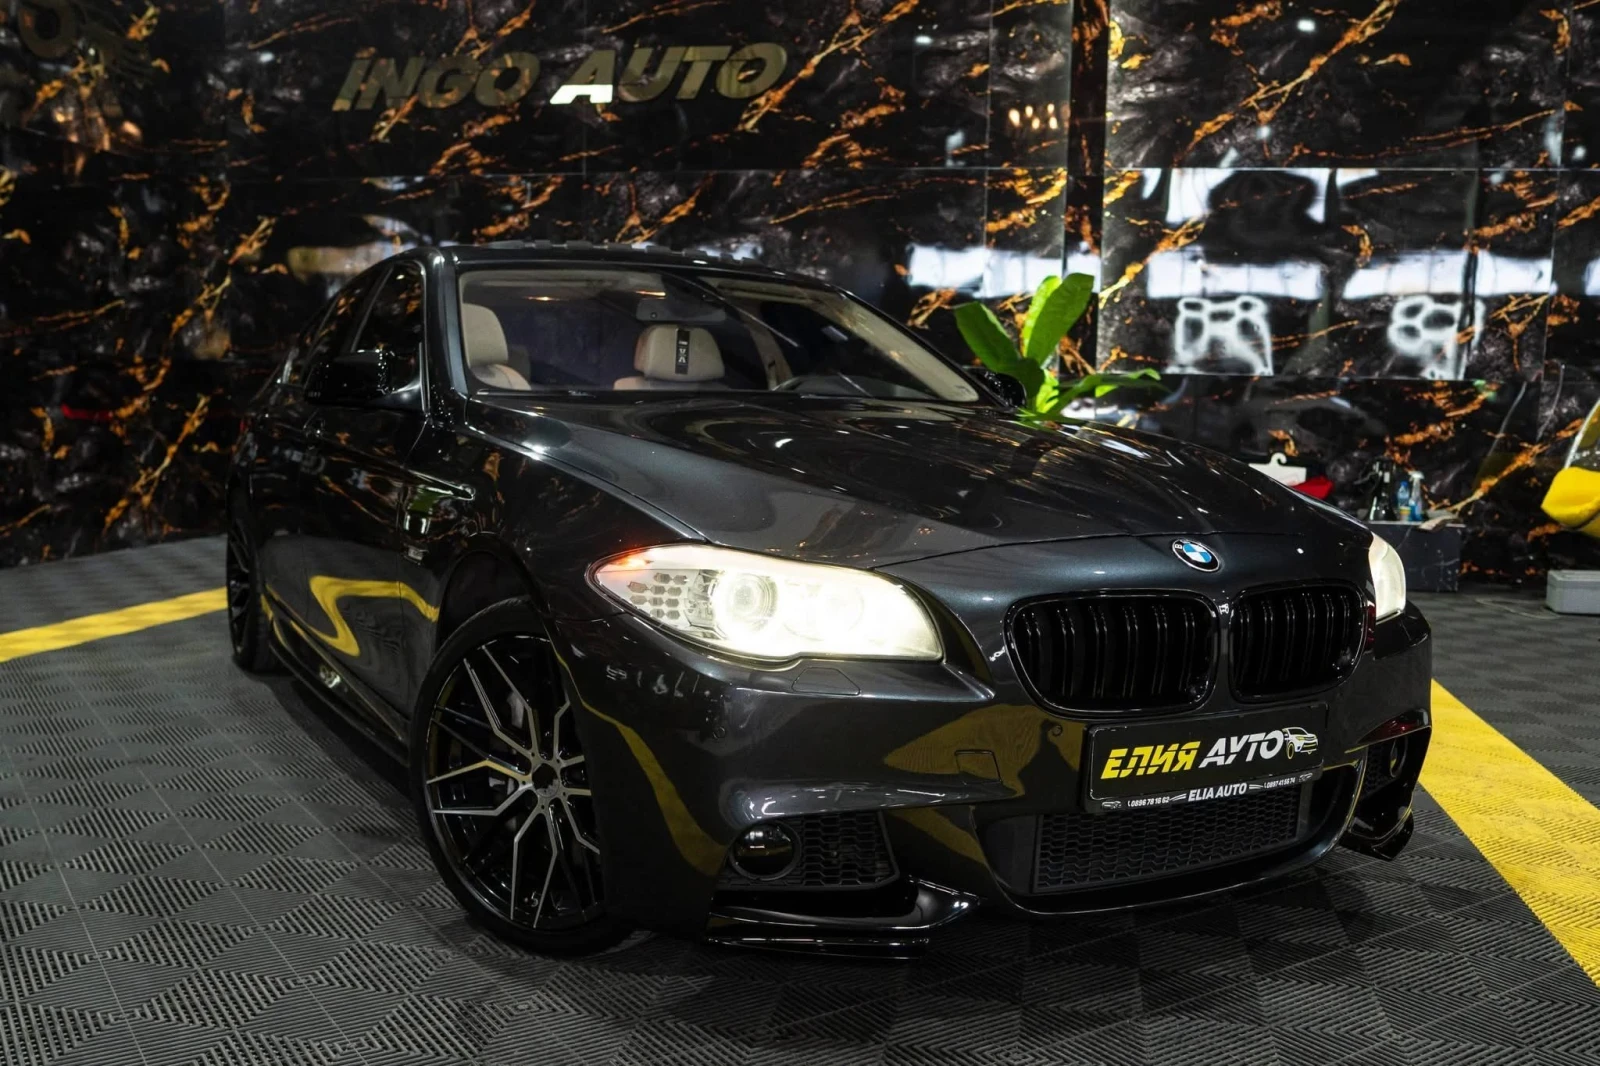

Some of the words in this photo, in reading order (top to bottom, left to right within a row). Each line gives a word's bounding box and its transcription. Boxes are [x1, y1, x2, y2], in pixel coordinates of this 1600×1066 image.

[332, 51, 540, 111] INGO
[549, 42, 788, 105] AUTO
[1101, 741, 1201, 780] ЕЛИЯ
[1199, 730, 1284, 768] АУТО
[1188, 787, 1214, 802] ELIA
[1215, 782, 1247, 798] AUTO
